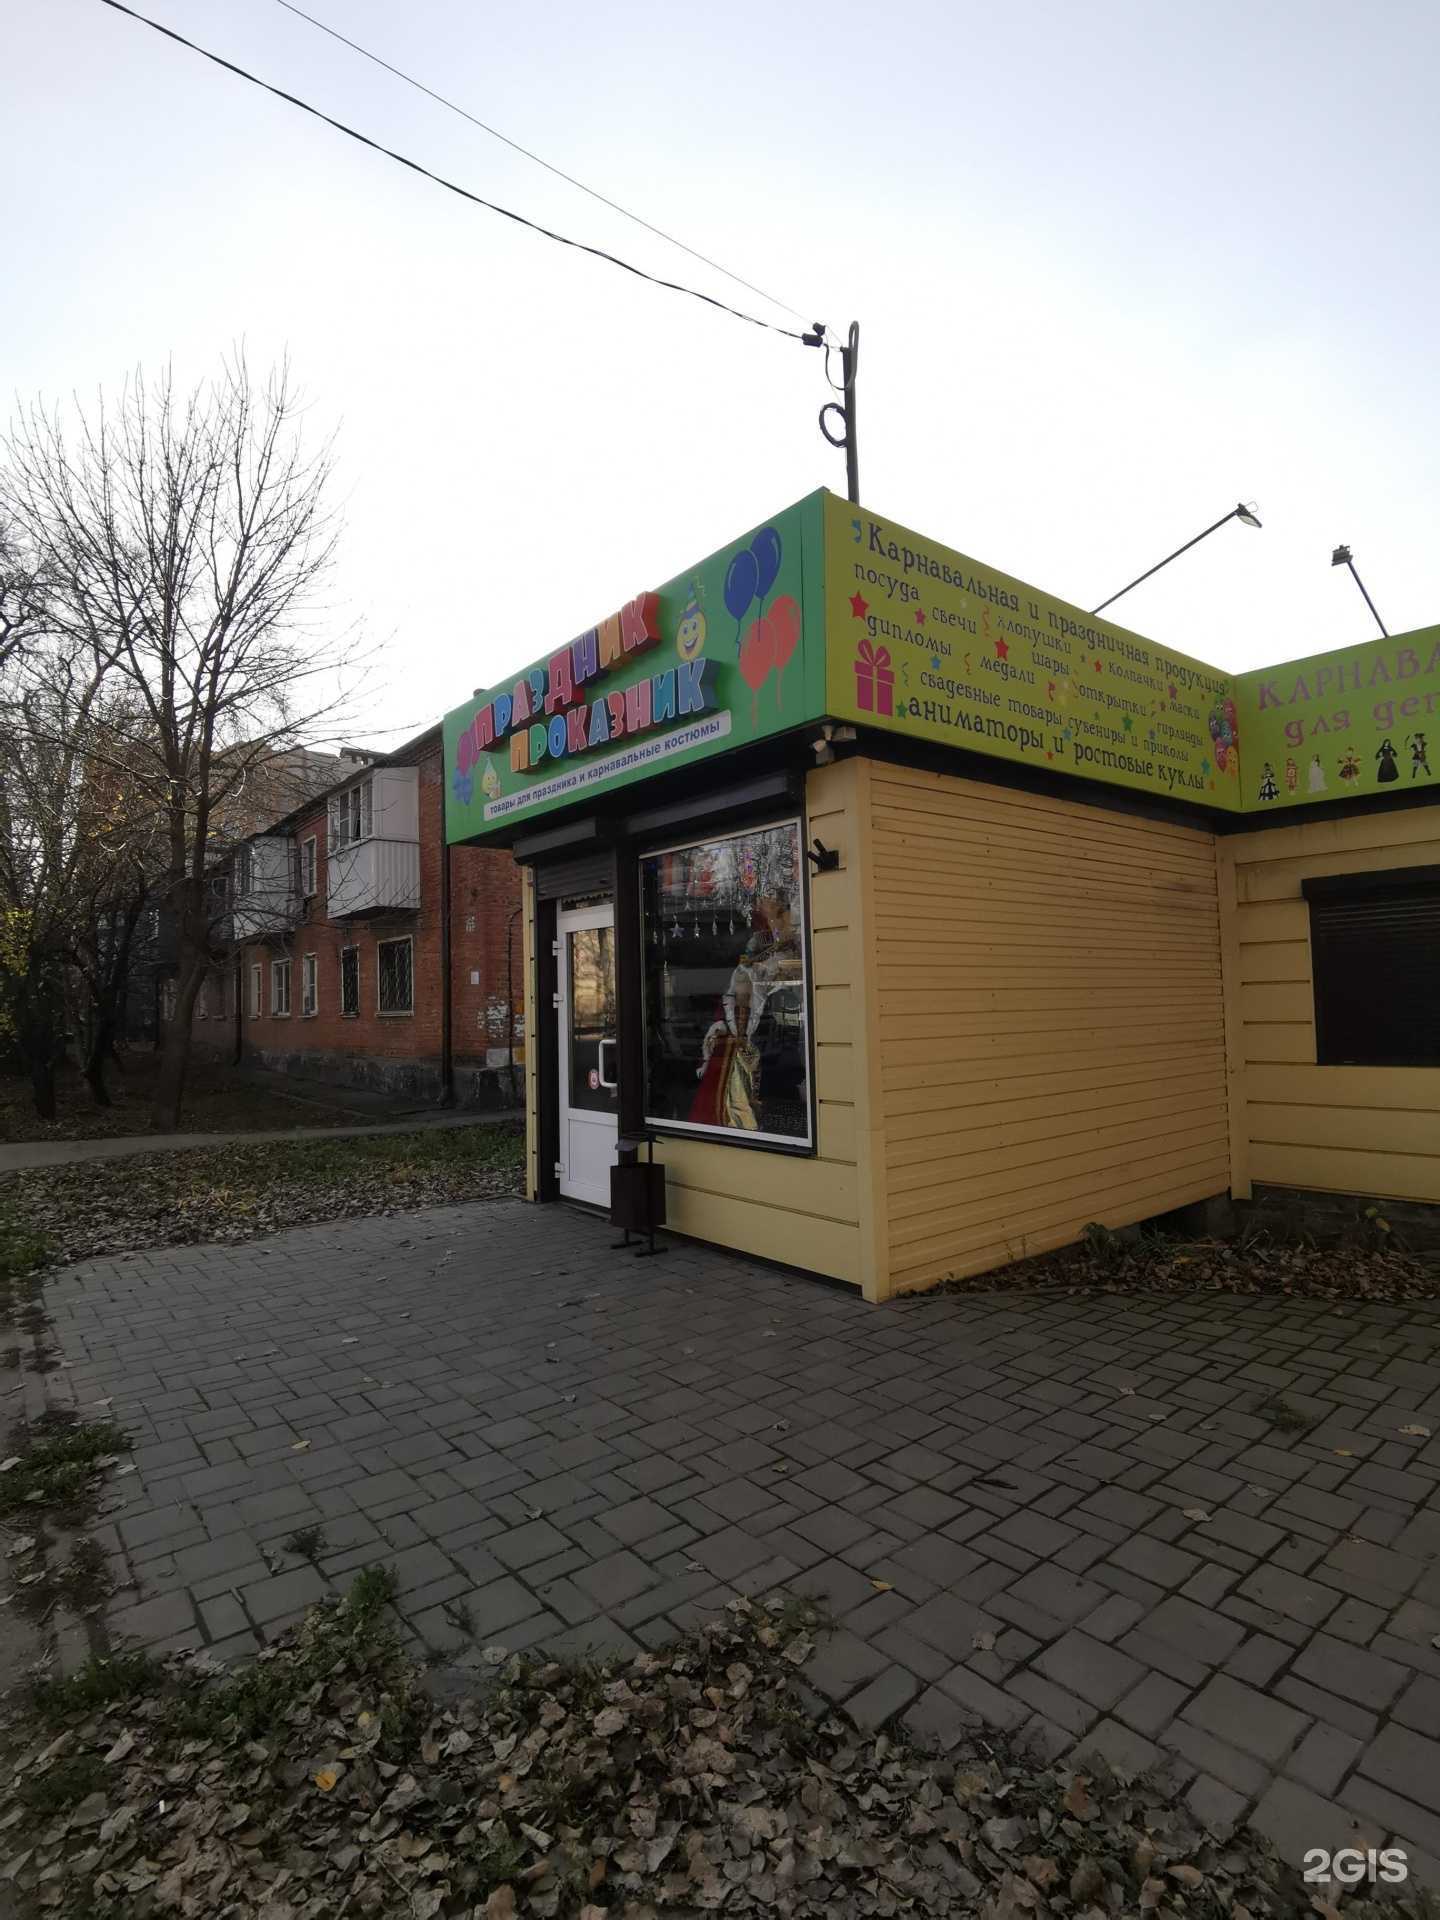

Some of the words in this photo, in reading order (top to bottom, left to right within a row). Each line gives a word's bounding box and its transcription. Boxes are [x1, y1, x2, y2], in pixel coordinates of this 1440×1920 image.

[855, 563, 920, 603] посуда
[932, 606, 977, 634] свечи
[998, 615, 1071, 655] хлопушки
[1109, 661, 1164, 692] колпачки
[1169, 700, 1200, 720] маски
[868, 522, 1019, 612] Карнавальная
[1028, 602, 1039, 620] и
[1048, 611, 1149, 666] праздничная
[1155, 655, 1226, 696] продукция
[474, 591, 655, 750] ПРАЗДНИК
[510, 658, 710, 772] ПРОКАЗНИК
[867, 615, 952, 656] дипломы
[980, 656, 1035, 684] медали
[1079, 683, 1147, 717] открытки
[1157, 722, 1203, 748] гирлянды
[1032, 651, 1070, 675] шары
[490, 800, 516, 815] товары
[517, 793, 531, 807] для
[532, 776, 577, 800] праздника
[579, 773, 585, 783] и
[587, 743, 661, 780] карнавальные
[664, 721, 721, 750] костюмы
[909, 697, 1044, 750] аниматоры
[1053, 736, 1064, 753] и
[1074, 740, 1153, 776] ростовые
[1158, 764, 1204, 790] куклы
[920, 671, 1001, 707] свадебные
[1008, 698, 1062, 726] товары
[1069, 717, 1126, 746] сувениры
[1131, 735, 1138, 748] и
[1143, 739, 1189, 761] приколы
[1283, 709, 1351, 748] для
